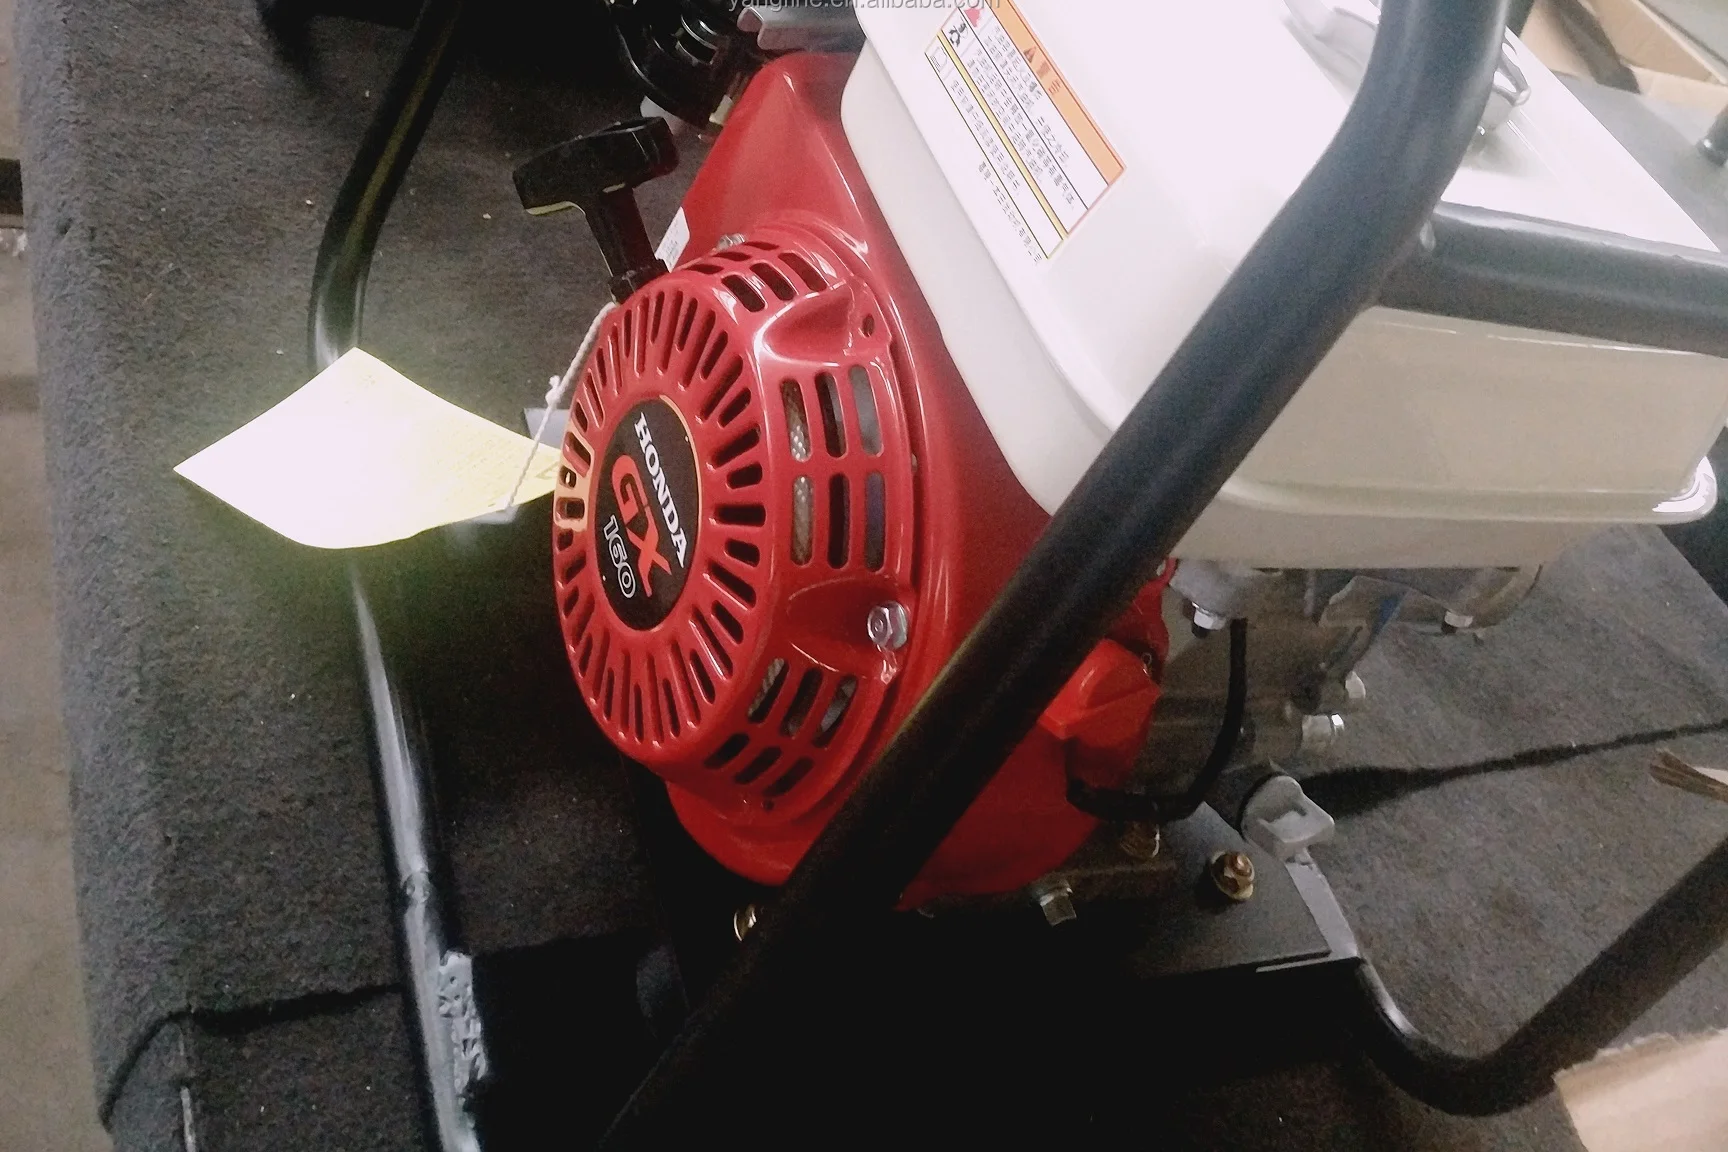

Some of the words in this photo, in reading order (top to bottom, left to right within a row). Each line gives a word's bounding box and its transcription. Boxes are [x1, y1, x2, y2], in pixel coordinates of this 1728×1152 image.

[603, 514, 636, 599] 160
[611, 454, 672, 598] GX
[634, 412, 687, 568] HONDA
